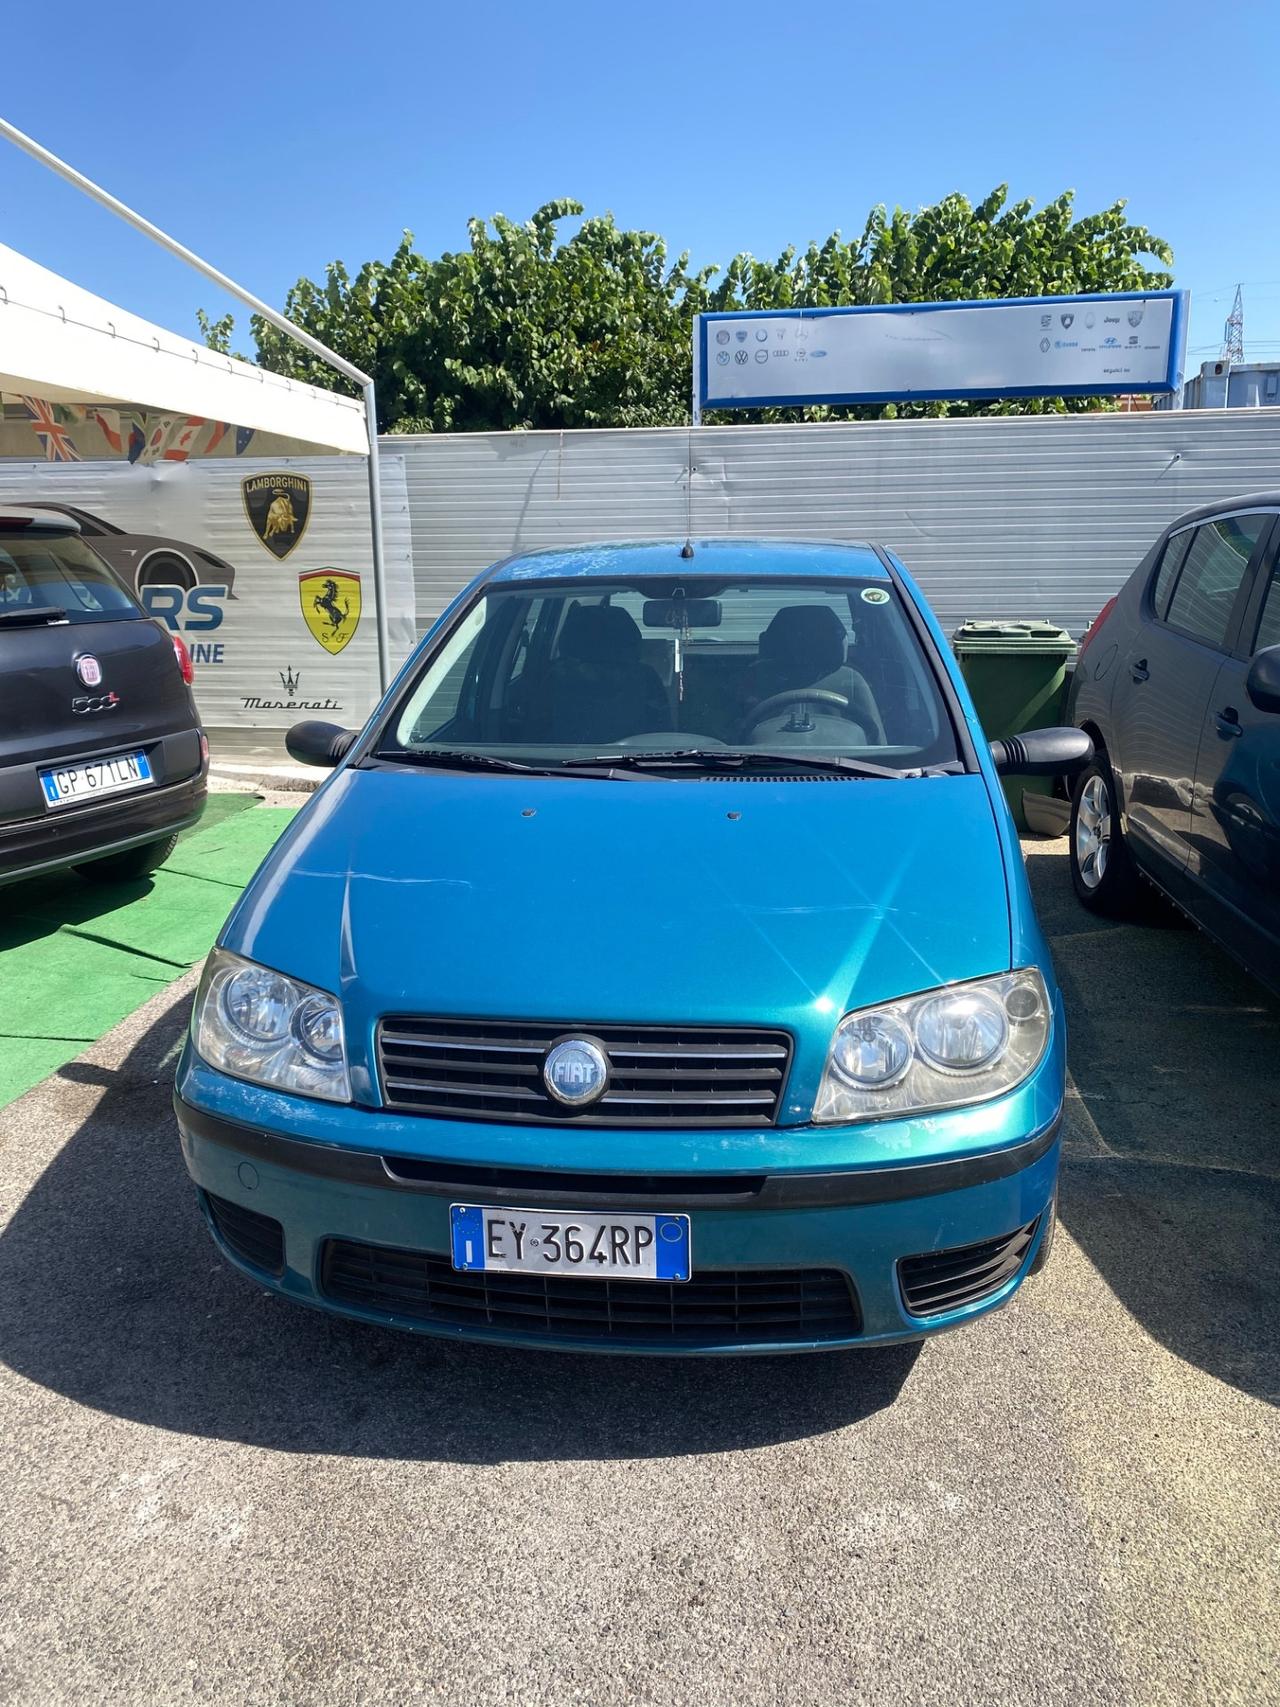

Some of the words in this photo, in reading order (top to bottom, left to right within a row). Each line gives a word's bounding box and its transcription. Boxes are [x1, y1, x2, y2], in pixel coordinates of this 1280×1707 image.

[246, 476, 307, 493] LAMBORGHINI
[189, 643, 224, 664] INE
[240, 697, 343, 710] Maserati
[56, 769, 78, 794] GP
[84, 755, 139, 788] 671LN
[553, 1060, 597, 1084] FIAT
[487, 1219, 527, 1260] EY
[541, 1224, 654, 1265] 364RP
